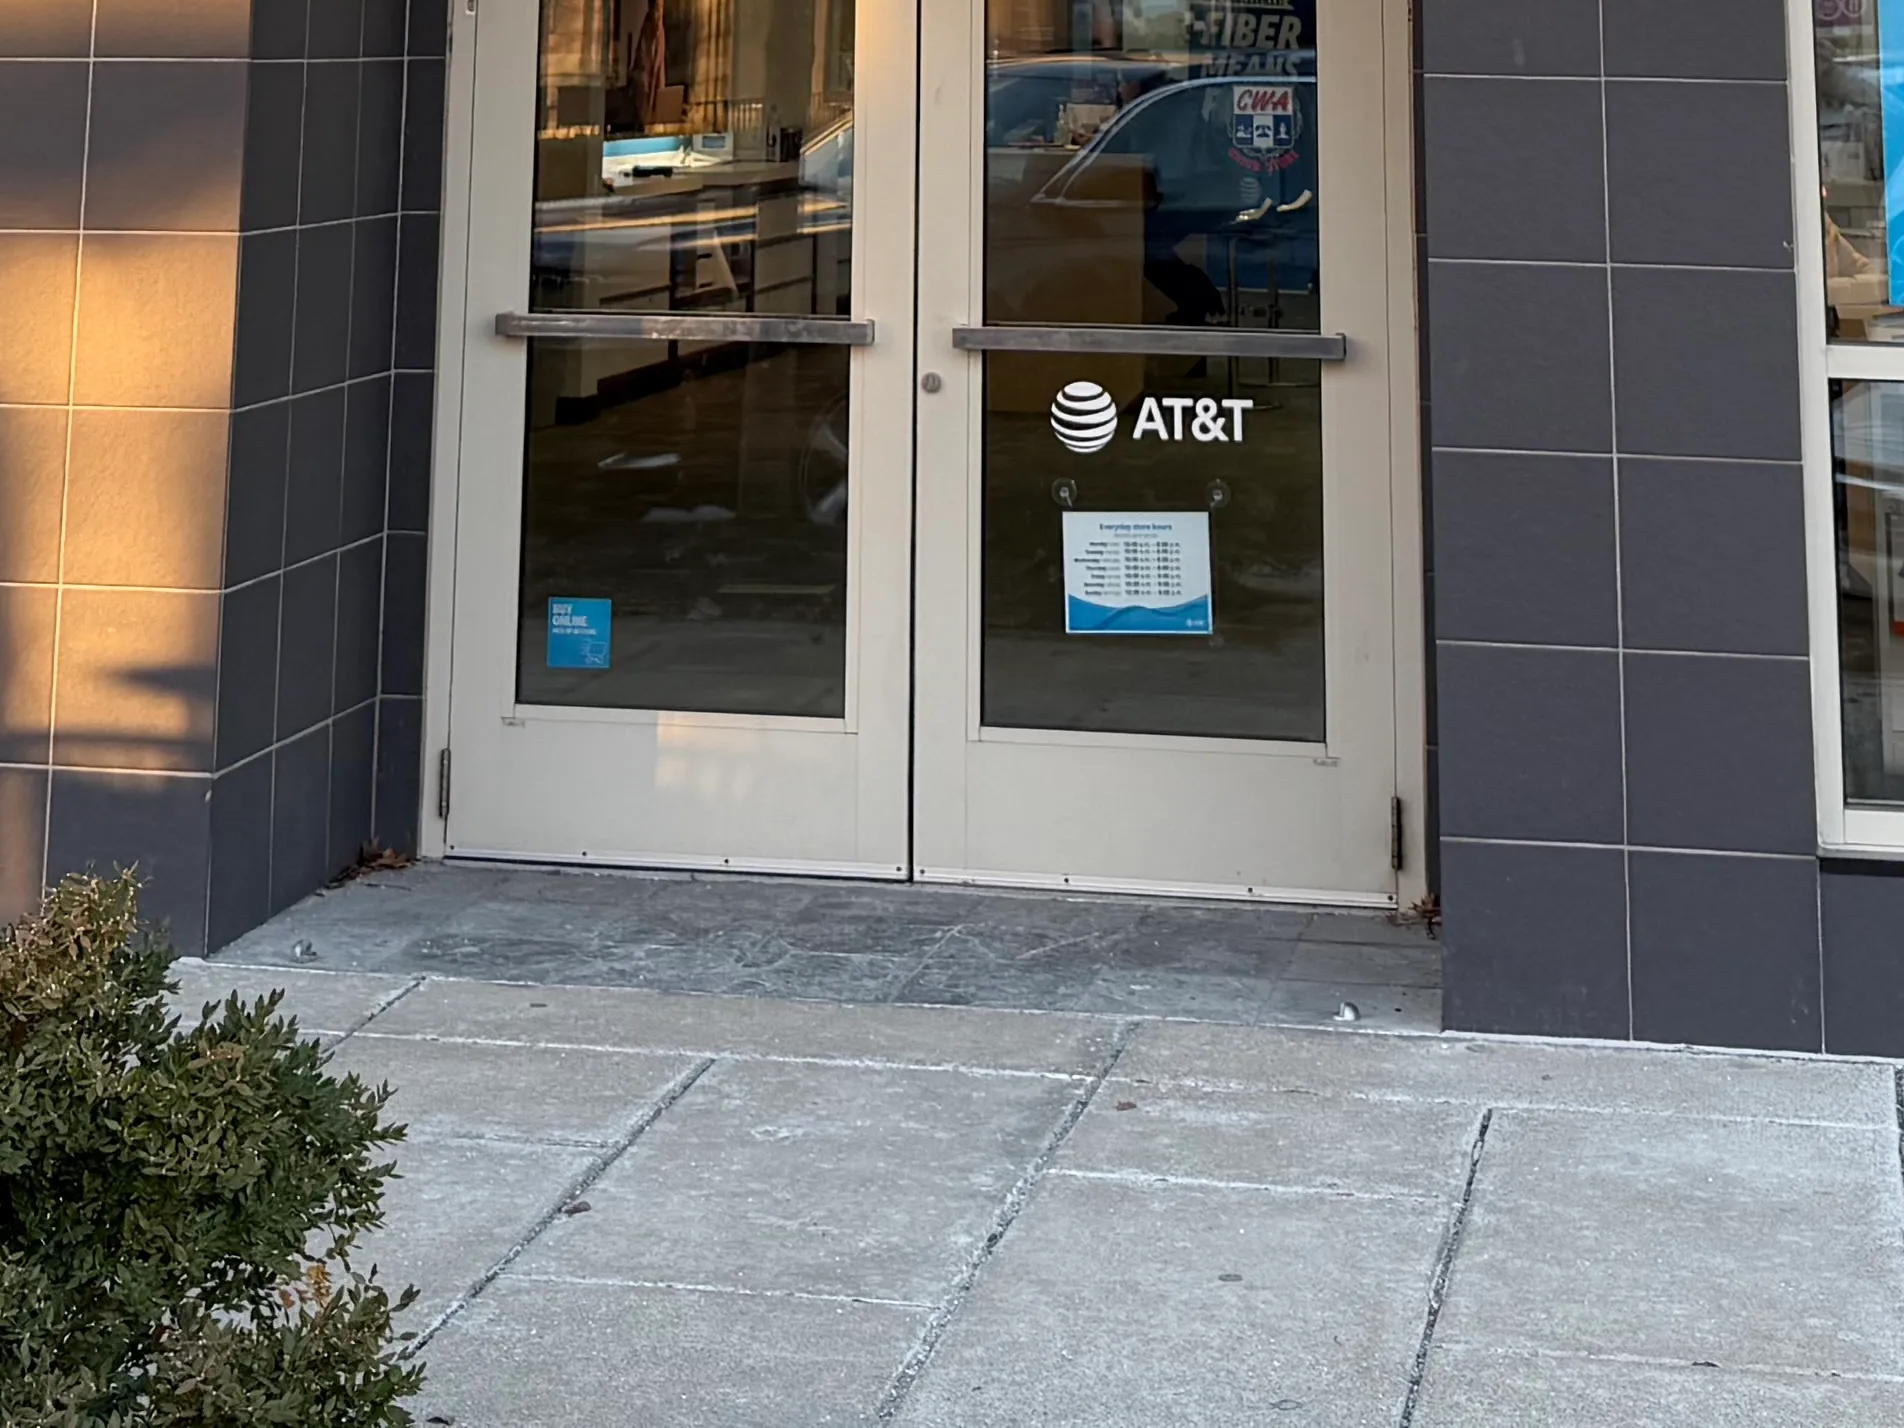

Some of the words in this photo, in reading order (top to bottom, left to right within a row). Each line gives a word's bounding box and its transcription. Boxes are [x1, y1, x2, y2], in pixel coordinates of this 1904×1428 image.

[1199, 11, 1302, 50] FIBER
[1236, 89, 1290, 112] CWA
[1132, 396, 1254, 442] AT&T
